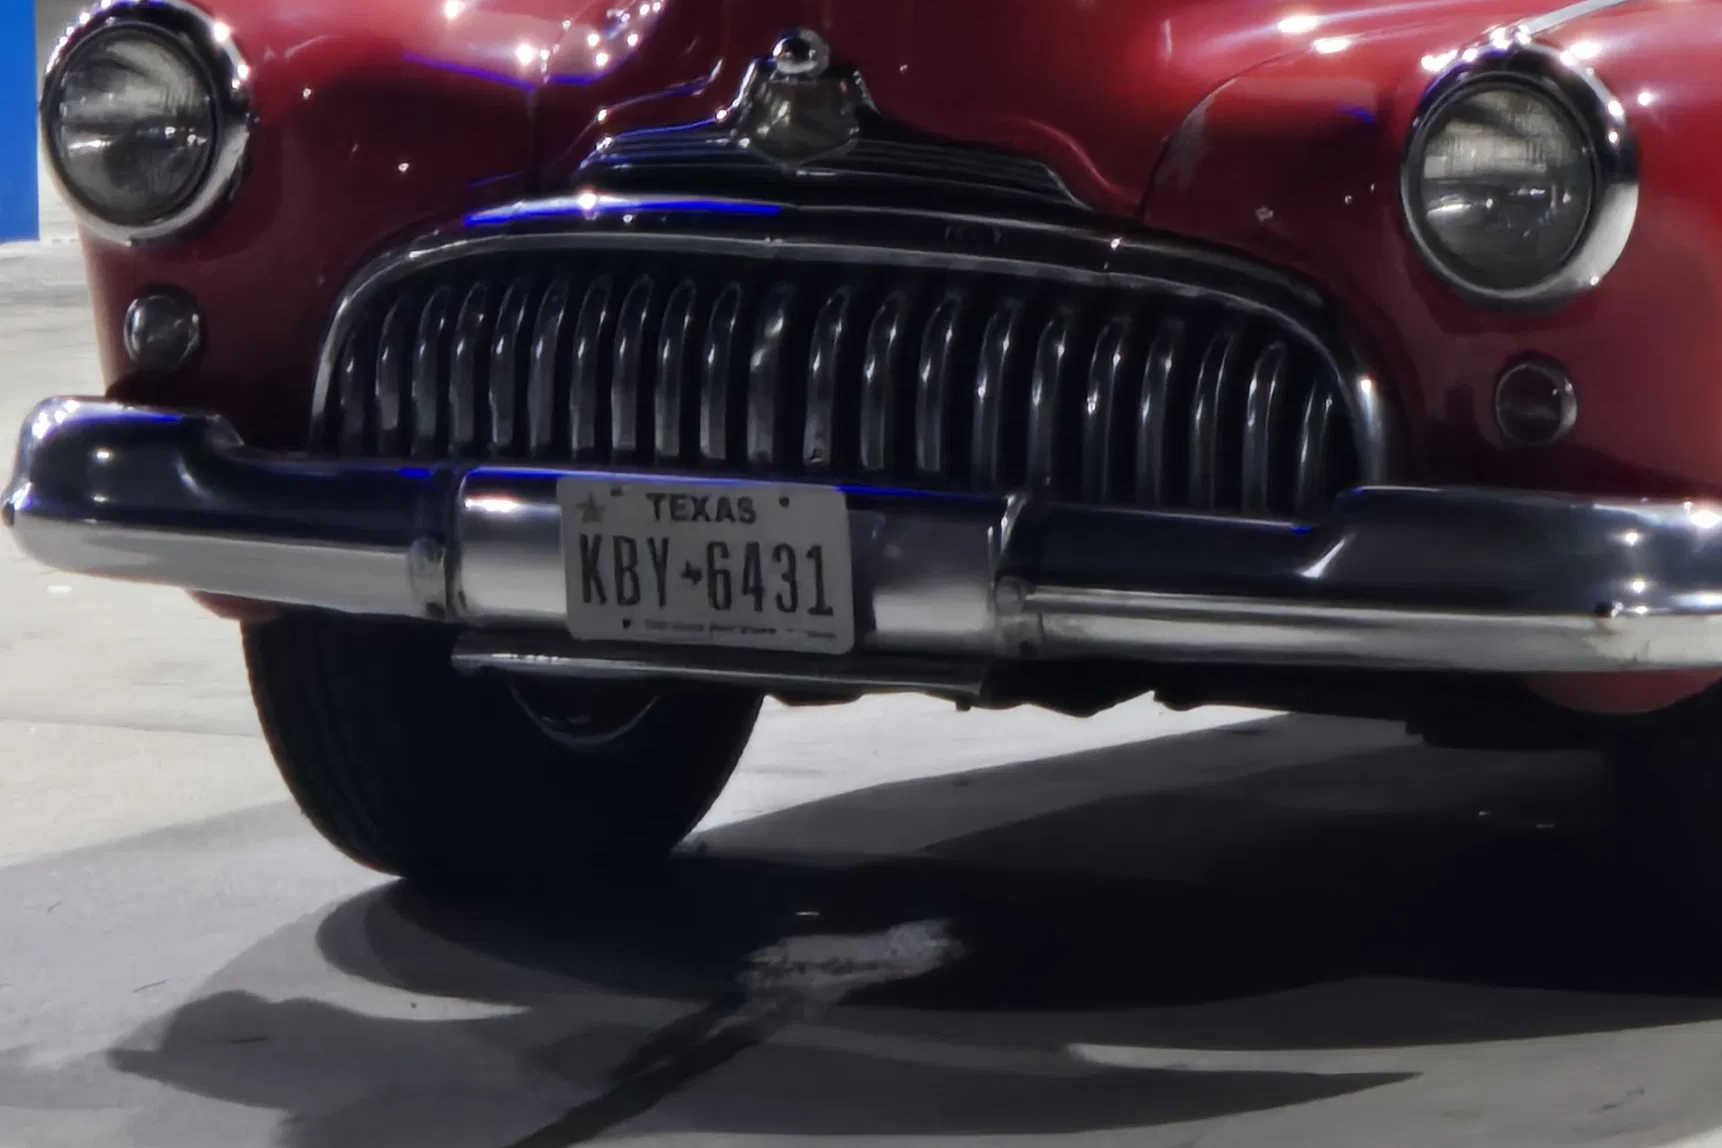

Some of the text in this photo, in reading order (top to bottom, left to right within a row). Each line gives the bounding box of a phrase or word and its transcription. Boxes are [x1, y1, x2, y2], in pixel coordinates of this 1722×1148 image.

[645, 492, 756, 524] TEXAS
[579, 533, 834, 616] KBY 6431
